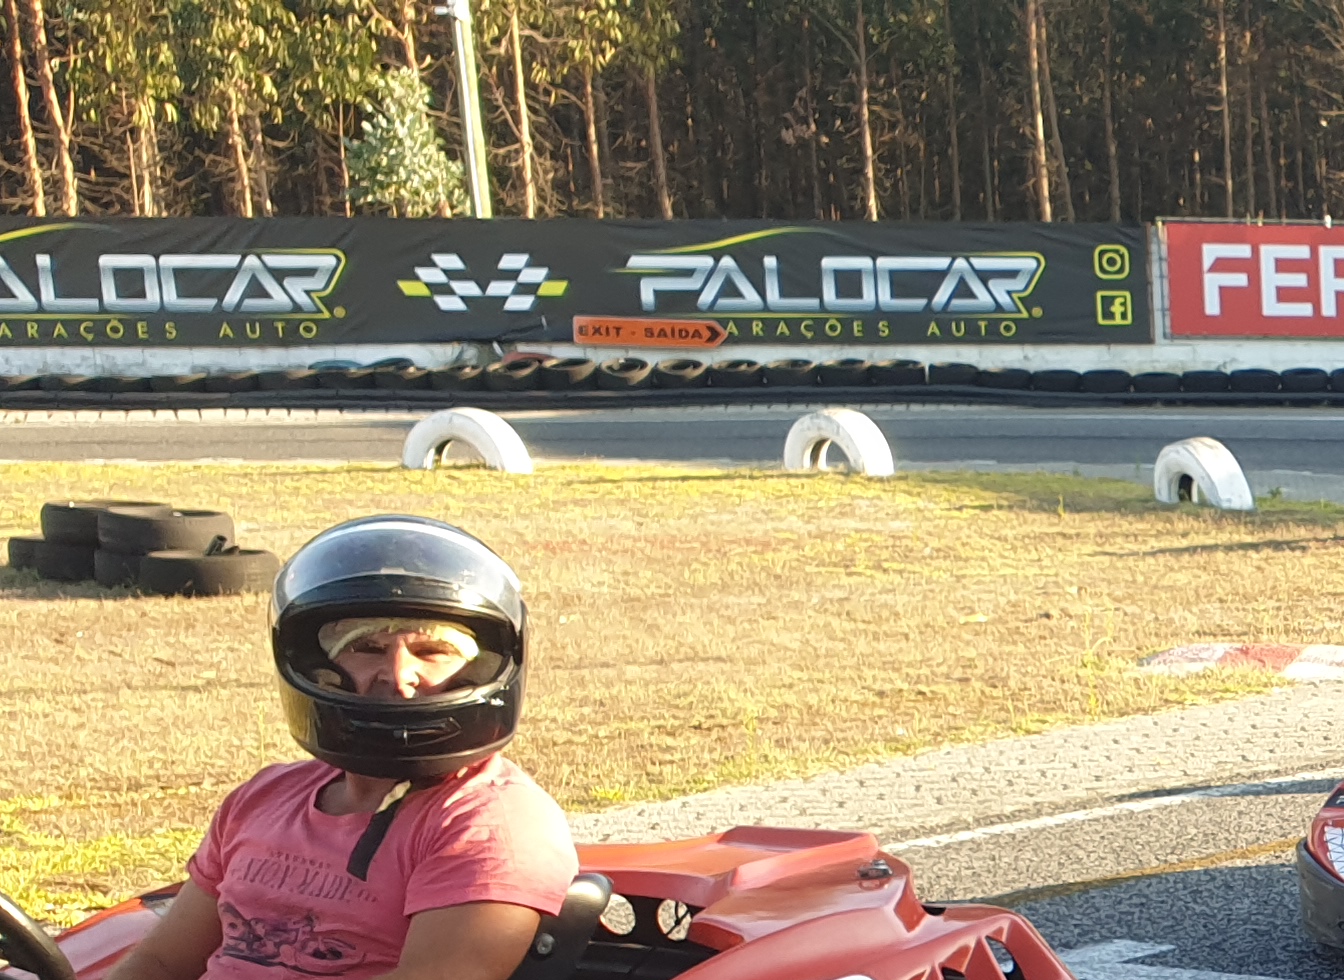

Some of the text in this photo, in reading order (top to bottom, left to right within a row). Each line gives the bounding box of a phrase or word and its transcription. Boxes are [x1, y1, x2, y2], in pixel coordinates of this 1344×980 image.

[0, 252, 340, 312] ALOCAR
[625, 254, 1038, 313] PALOCAR
[0, 319, 318, 342] ARAÇÕES AUTO
[578, 324, 623, 339] EXIT
[643, 326, 704, 339] SAÍDA
[725, 317, 1018, 340] ARAÇÕES AUTO
